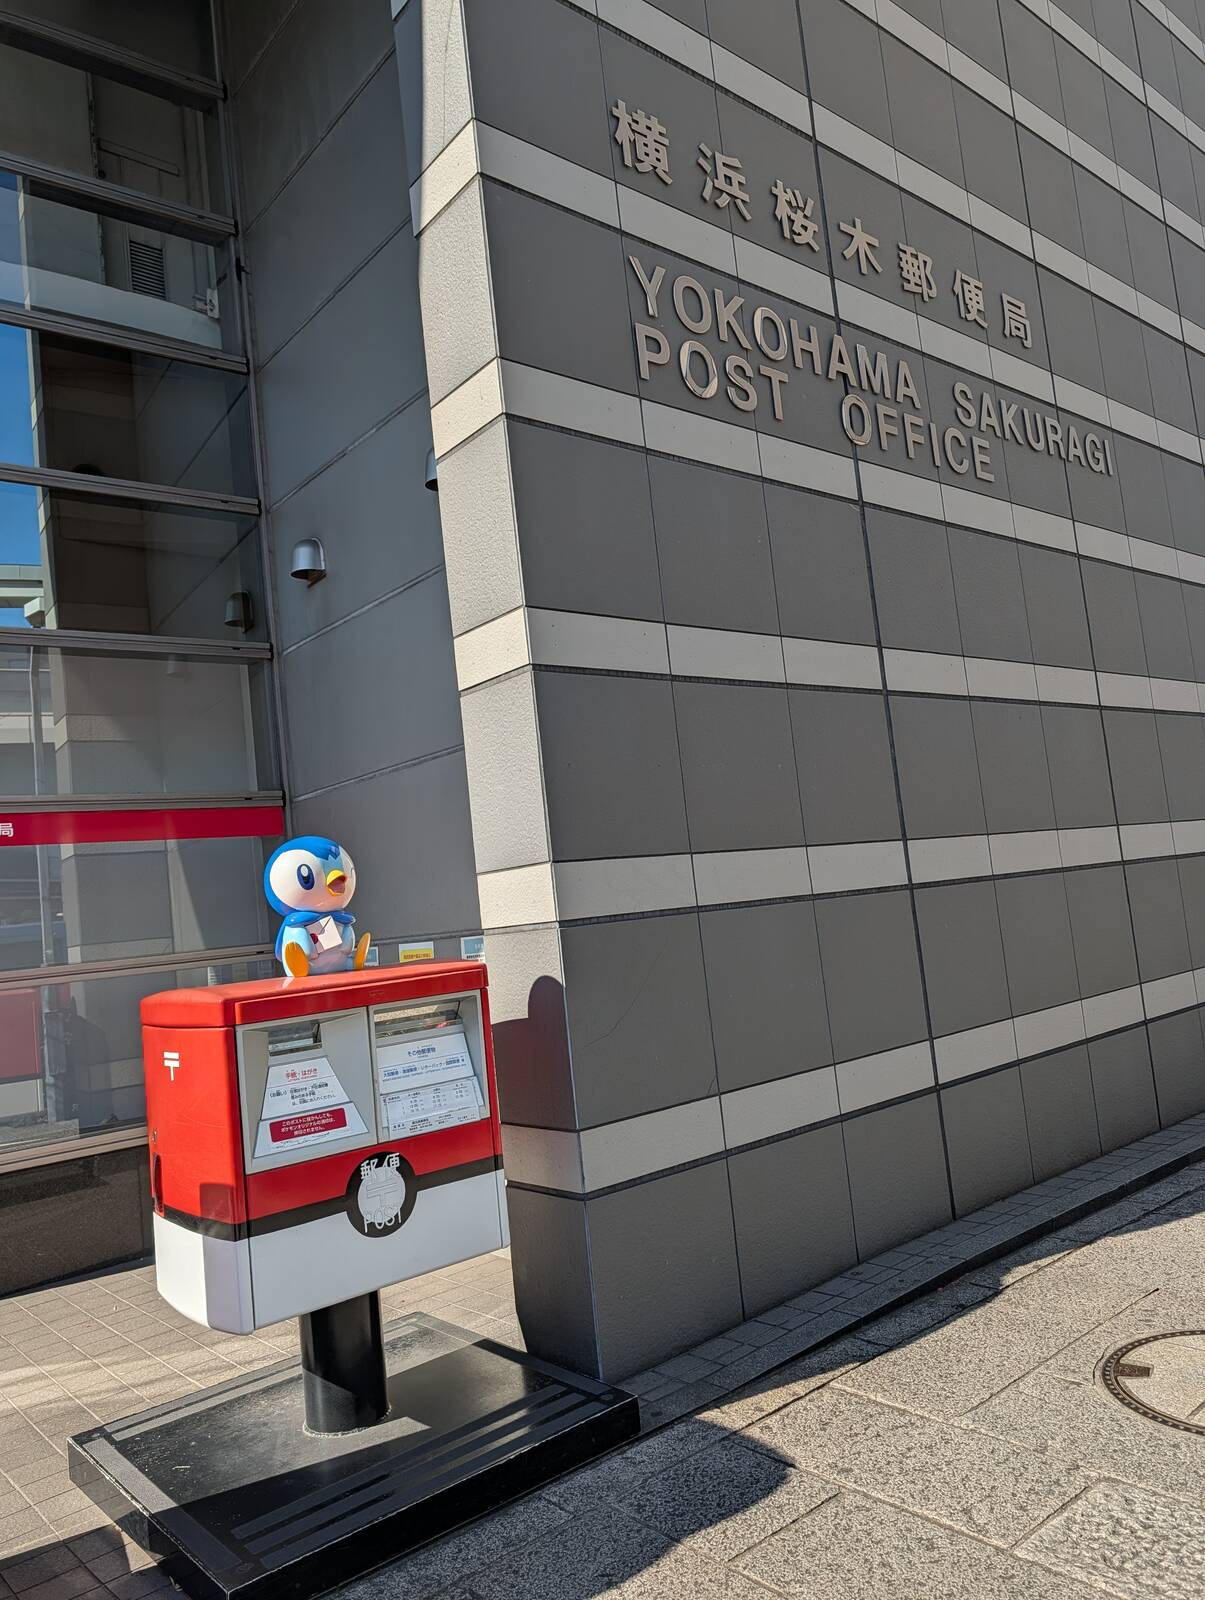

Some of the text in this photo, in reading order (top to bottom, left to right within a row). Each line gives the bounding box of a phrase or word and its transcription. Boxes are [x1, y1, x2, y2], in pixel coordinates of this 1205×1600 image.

[612, 100, 1032, 349] 横浜桜木郵便局
[629, 255, 1113, 476] YOKOHAMA SAKURAGI
[635, 322, 995, 483] POST OFFICE
[360, 1152, 400, 1184] 郵便
[363, 1204, 402, 1233] POST
